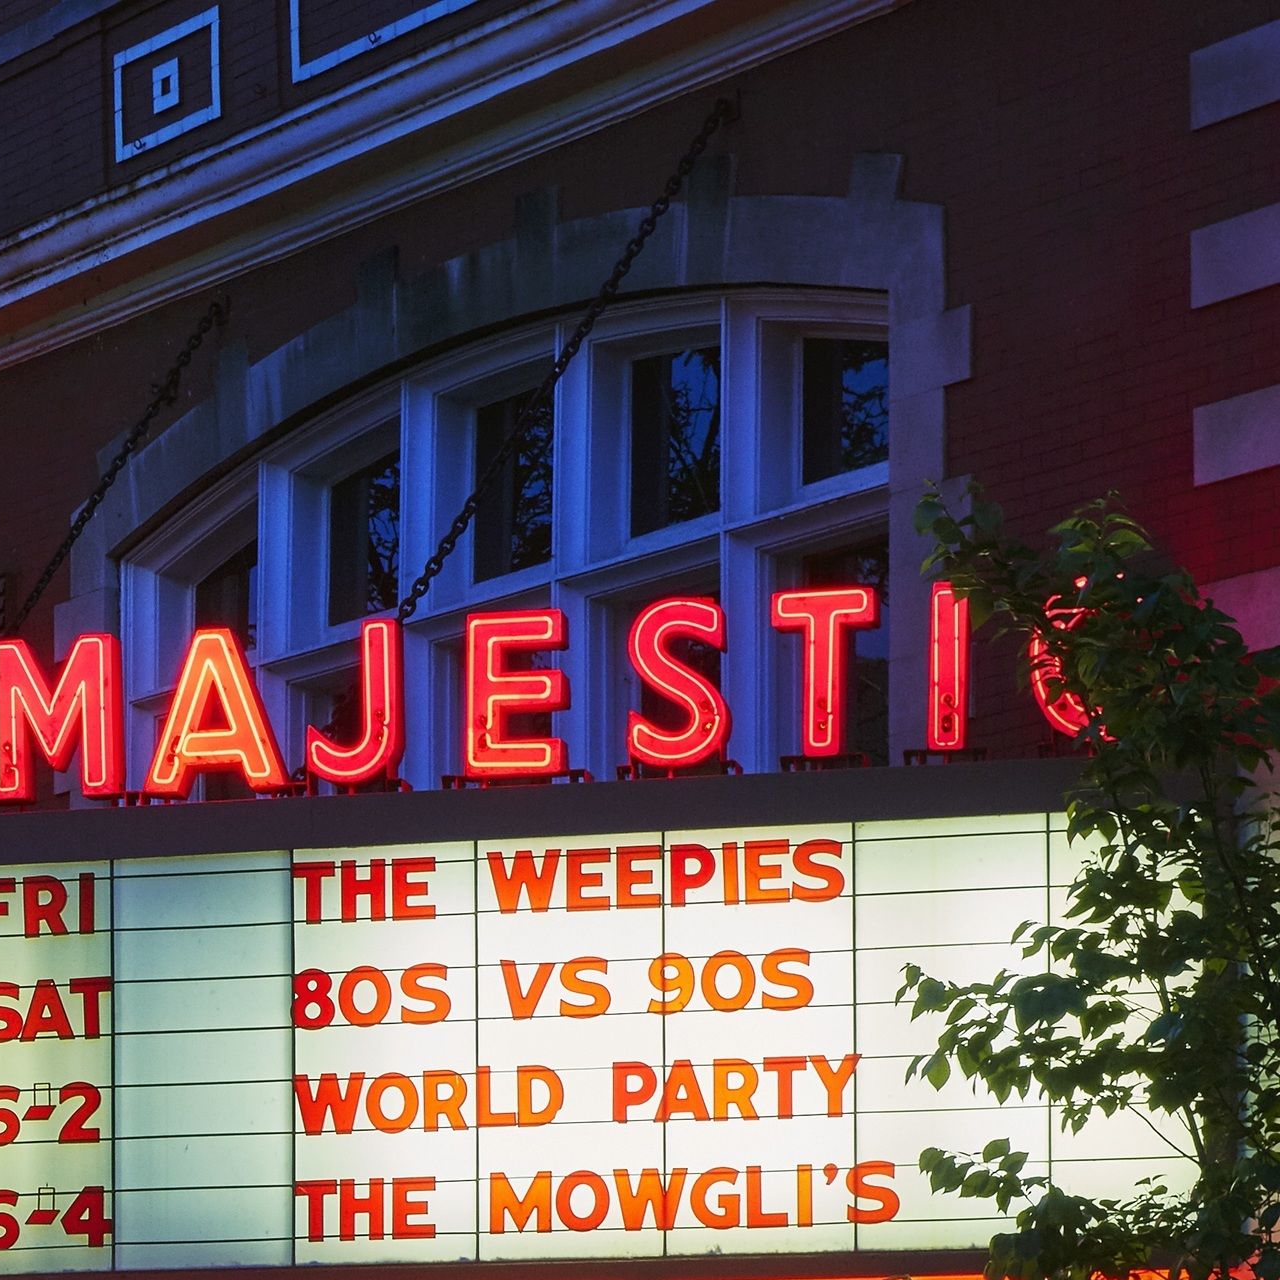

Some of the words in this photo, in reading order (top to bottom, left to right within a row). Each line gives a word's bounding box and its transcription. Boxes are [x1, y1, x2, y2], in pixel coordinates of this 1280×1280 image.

[294, 856, 436, 924] THE
[487, 839, 845, 914] WEEPIES
[291, 962, 451, 1030] 80S
[500, 956, 612, 1020] VS
[647, 948, 815, 1015] 90S
[294, 1065, 564, 1136] WORLD
[613, 1053, 862, 1123] PARTY
[295, 1176, 436, 1243] THE
[490, 1161, 900, 1233] MOWGLI'S
